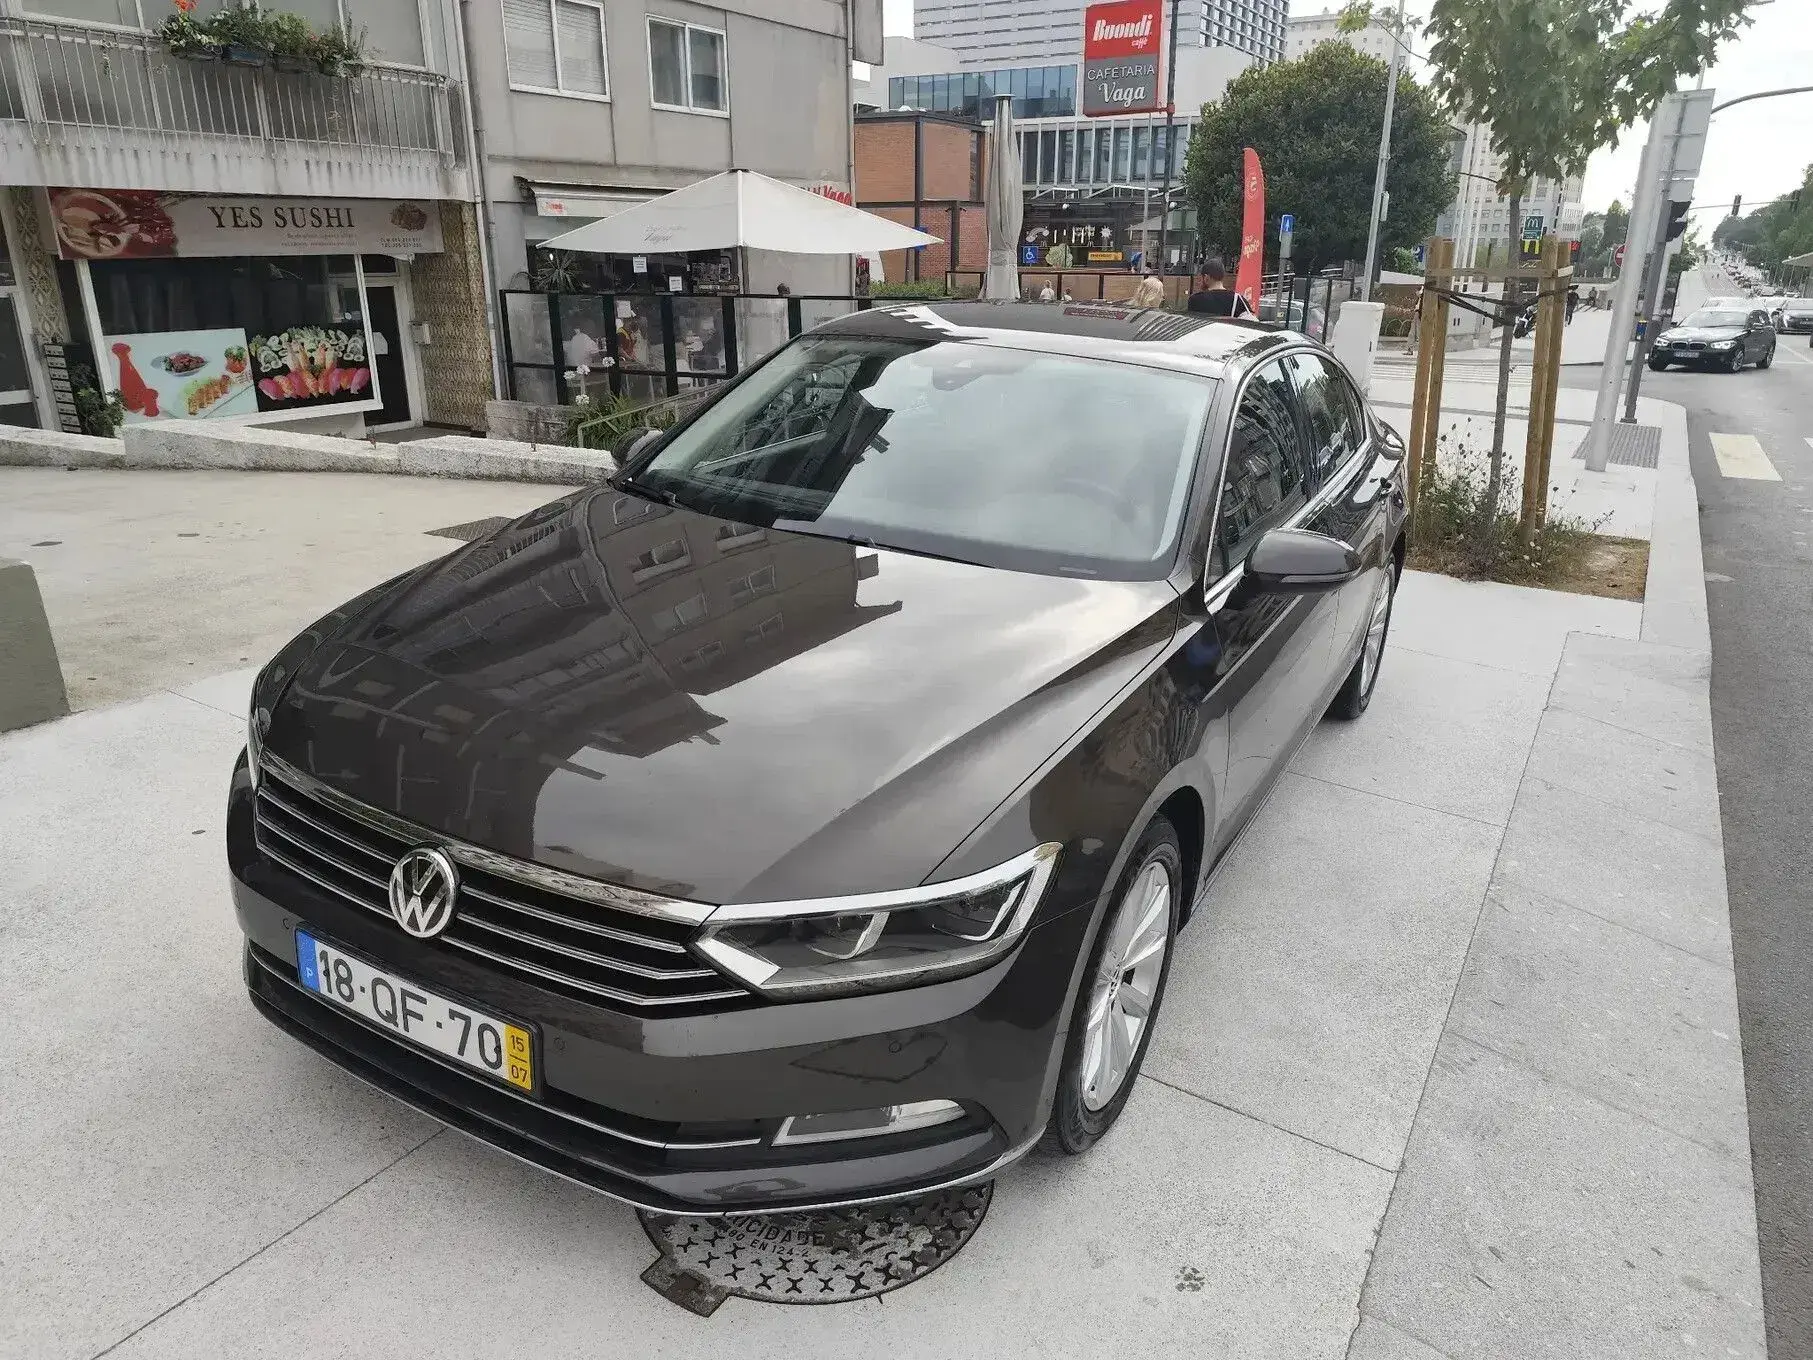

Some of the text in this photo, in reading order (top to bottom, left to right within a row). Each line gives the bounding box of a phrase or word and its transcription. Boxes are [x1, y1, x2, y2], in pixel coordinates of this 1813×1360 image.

[1093, 14, 1153, 41] Buondi
[1087, 65, 1155, 80] CAFETARIA
[1099, 82, 1146, 107] Vaga
[207, 206, 355, 228] YES SUSHI
[305, 967, 314, 978] P
[510, 1034, 525, 1052] 15
[511, 1064, 528, 1082] 07
[750, 1239, 768, 1251] EN
